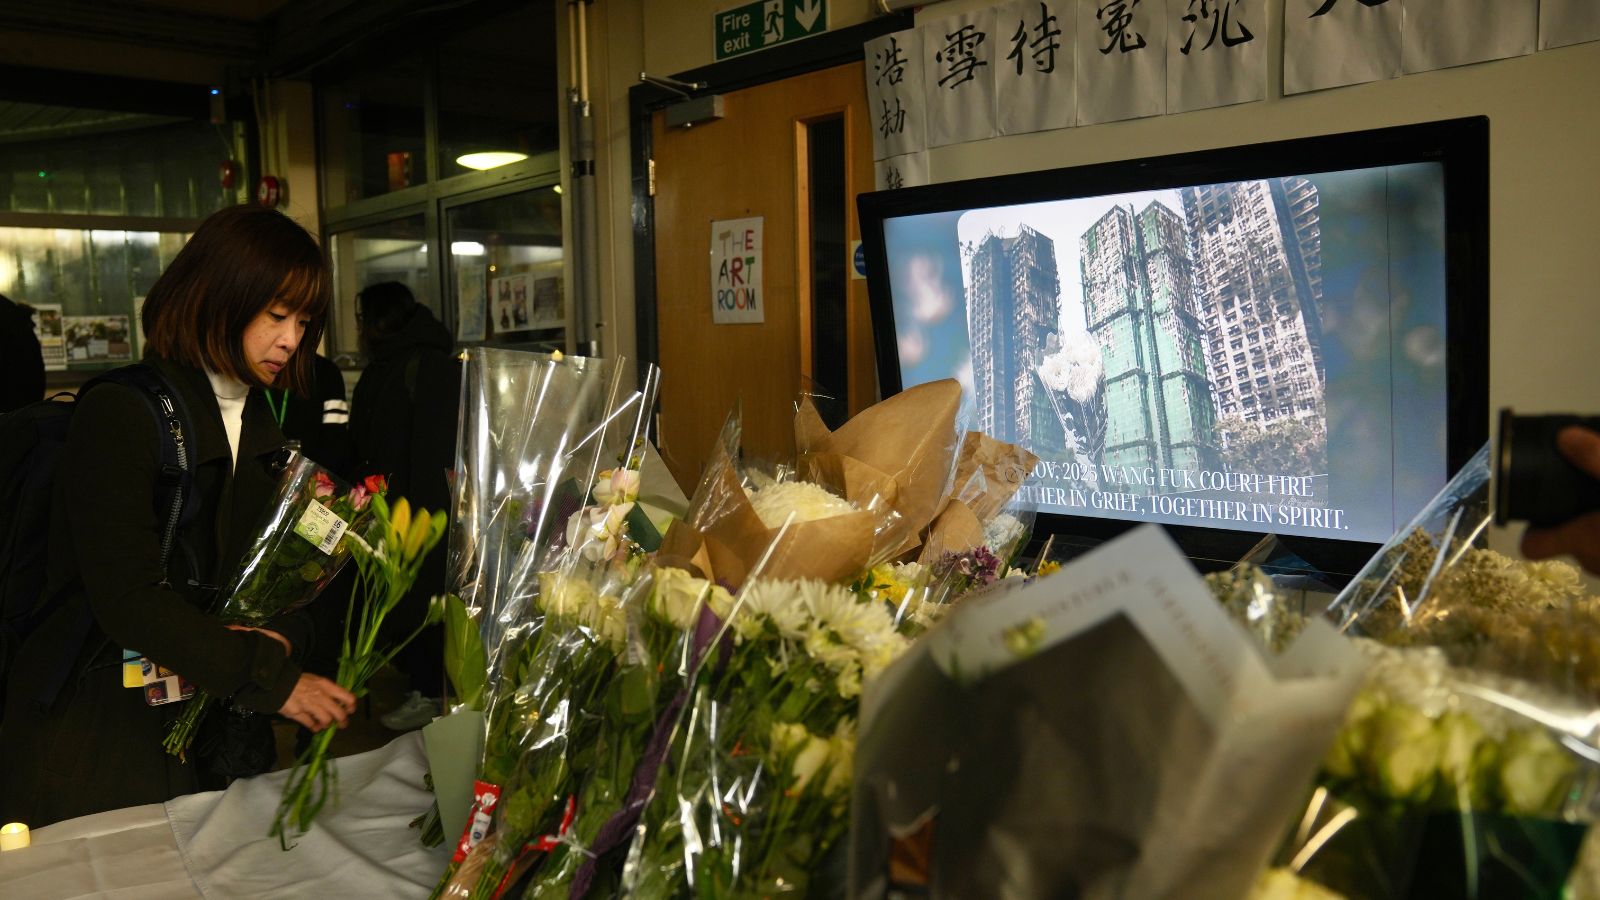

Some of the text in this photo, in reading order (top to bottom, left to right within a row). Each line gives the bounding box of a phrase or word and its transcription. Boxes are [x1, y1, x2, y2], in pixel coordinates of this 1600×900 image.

[722, 13, 750, 33] Fire
[723, 32, 751, 53] exit
[719, 229, 755, 257] THE
[719, 256, 755, 288] ART
[717, 288, 756, 311] ROOM
[1030, 460, 1314, 497] OV, 2025 WANG FUK COURT FIRE
[1070, 489, 1087, 508] IN
[1091, 491, 1145, 516] GRIEF,
[1150, 496, 1248, 522] TOGETHER
[1252, 503, 1274, 524] IN
[1278, 505, 1349, 530] SPIRIT.
